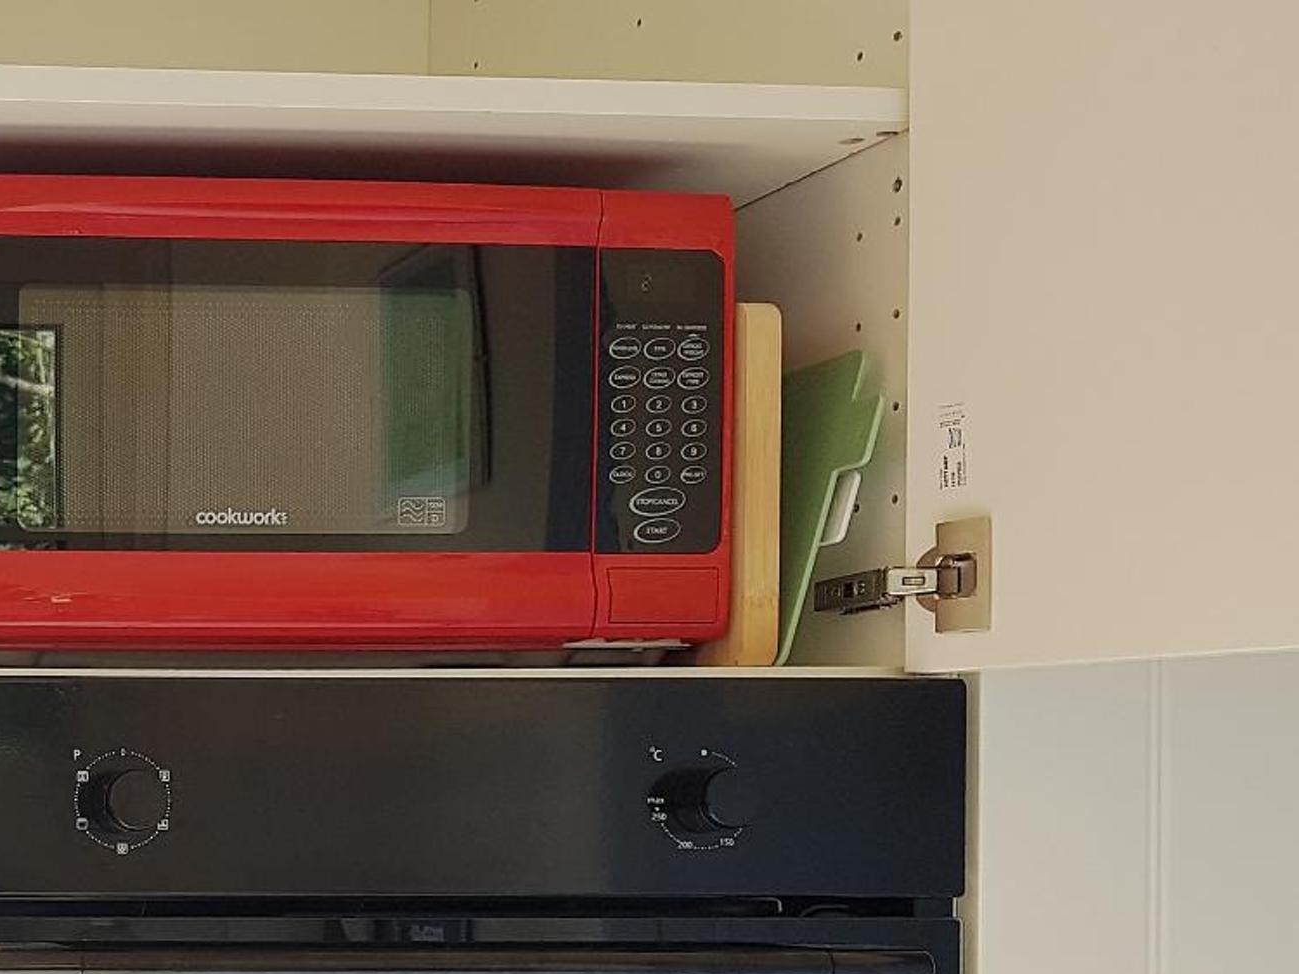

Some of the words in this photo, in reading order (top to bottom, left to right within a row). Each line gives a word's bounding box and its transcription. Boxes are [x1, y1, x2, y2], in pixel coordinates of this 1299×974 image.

[621, 399, 627, 409] 1
[656, 399, 662, 410] 2
[691, 399, 697, 410] 3
[620, 423, 627, 432] 4
[655, 423, 662, 433] 5
[690, 423, 697, 433] 6
[619, 446, 626, 455] 7
[655, 446, 662, 456] 8
[690, 446, 698, 456] 9
[73, 748, 82, 760] P
